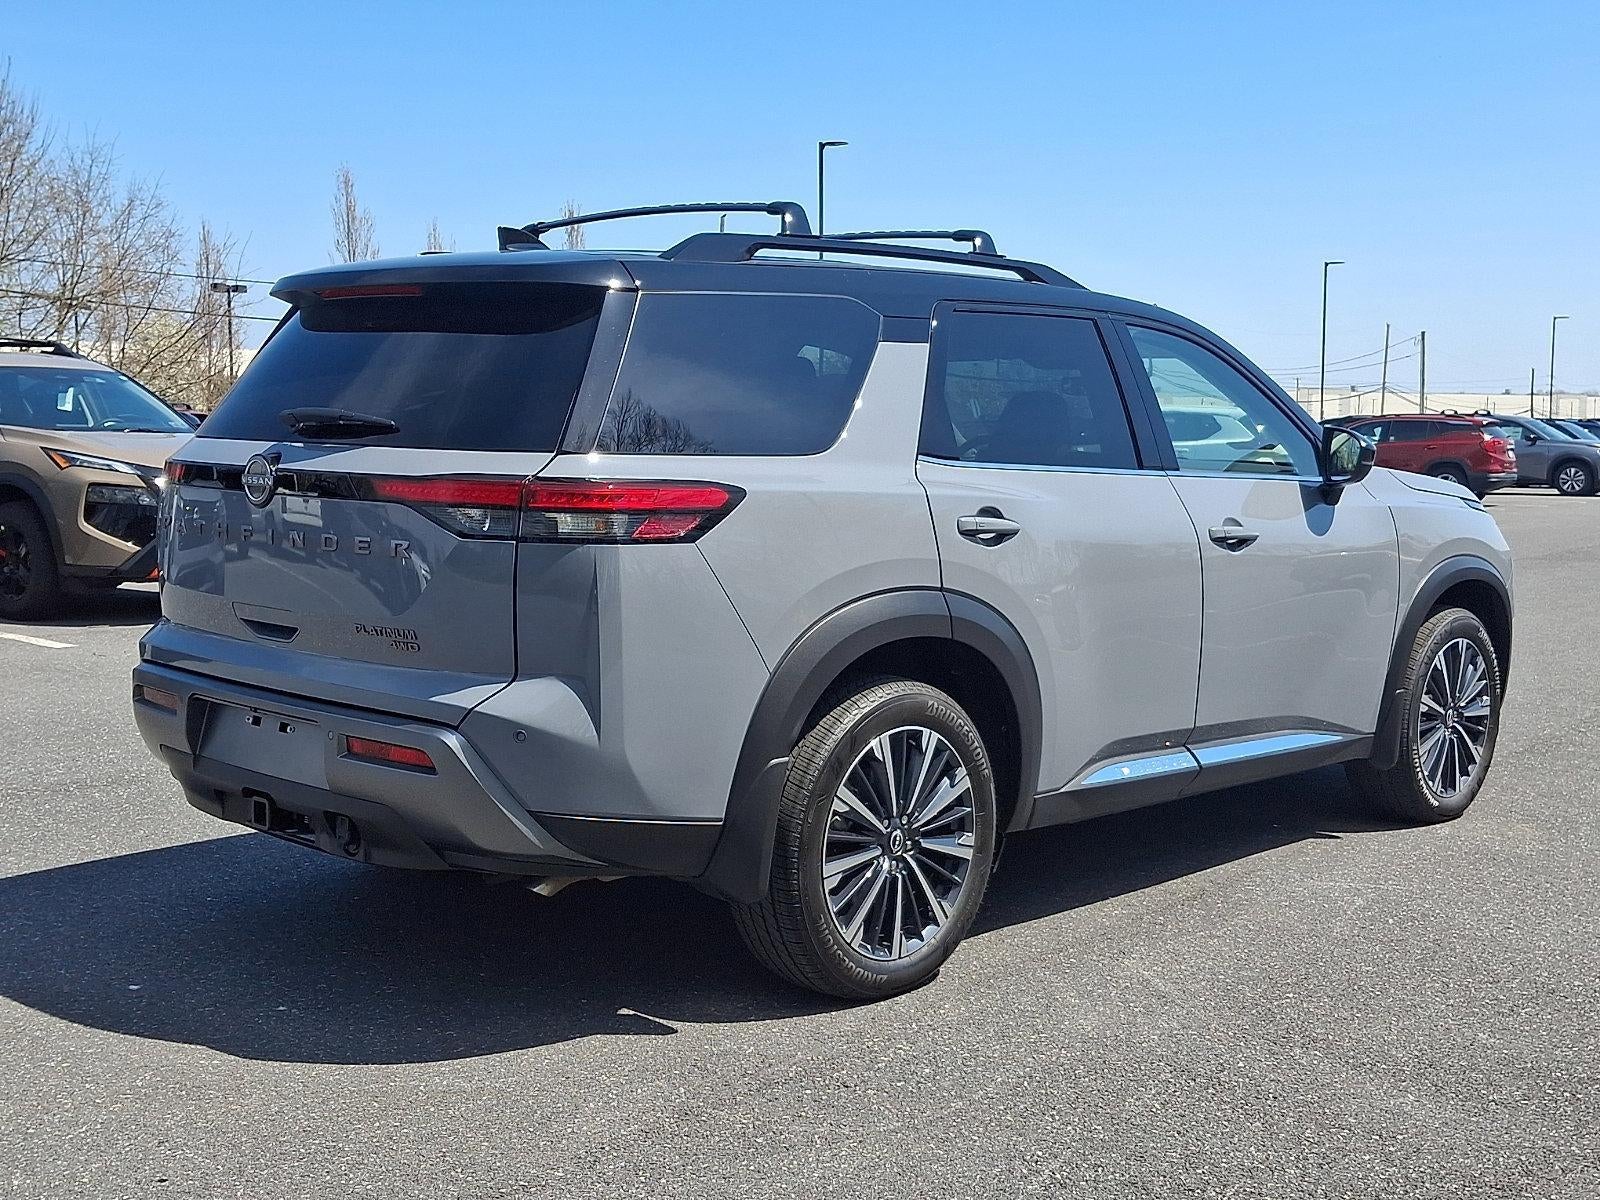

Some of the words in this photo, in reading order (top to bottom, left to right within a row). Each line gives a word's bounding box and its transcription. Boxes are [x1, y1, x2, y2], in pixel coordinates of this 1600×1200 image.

[241, 474, 273, 486] NISSAN
[160, 513, 412, 559] PATHFINDER
[354, 622, 418, 641] PLATINUM
[390, 639, 421, 652] 4WD
[926, 700, 990, 780] BRIDGESTONE
